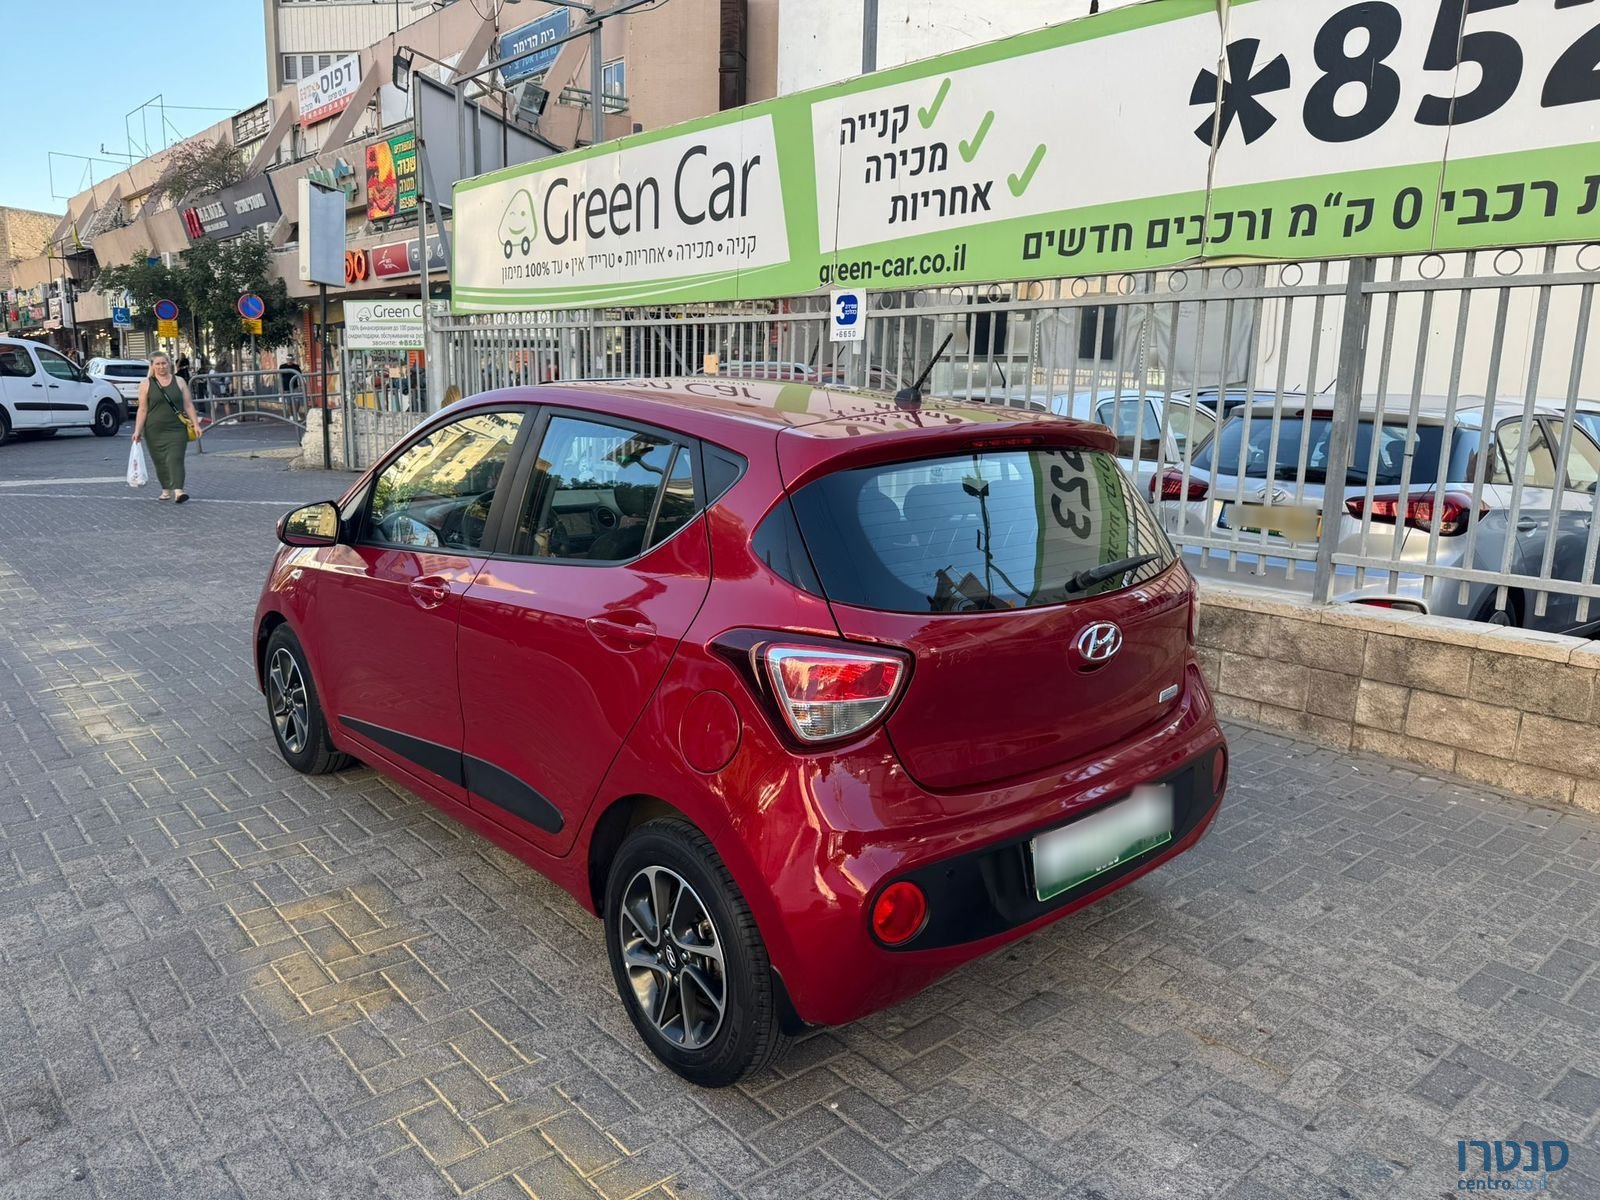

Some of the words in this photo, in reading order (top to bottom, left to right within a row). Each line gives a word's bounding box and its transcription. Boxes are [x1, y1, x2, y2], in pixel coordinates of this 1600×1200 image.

[541, 28, 556, 44] בית
[320, 62, 351, 94] דפוס
[840, 104, 910, 145] קנייה
[865, 142, 948, 184] מכירה
[544, 177, 660, 245] Green
[674, 145, 760, 225] Car
[888, 181, 994, 224] אחריות
[1393, 187, 1423, 230] 0
[1441, 180, 1559, 225] רכבי
[1023, 222, 1133, 260] חדשים
[1146, 208, 1272, 249] ורכבים
[625, 246, 666, 267] אחריות
[676, 240, 714, 261] מכירה
[726, 235, 757, 259] קניה
[501, 265, 523, 285] מימון
[525, 261, 551, 278] 100%
[551, 260, 563, 274] עד
[571, 257, 585, 277] אין
[588, 253, 615, 270] טרייד
[819, 244, 967, 287] green-car.co.il
[373, 304, 410, 318] Green
